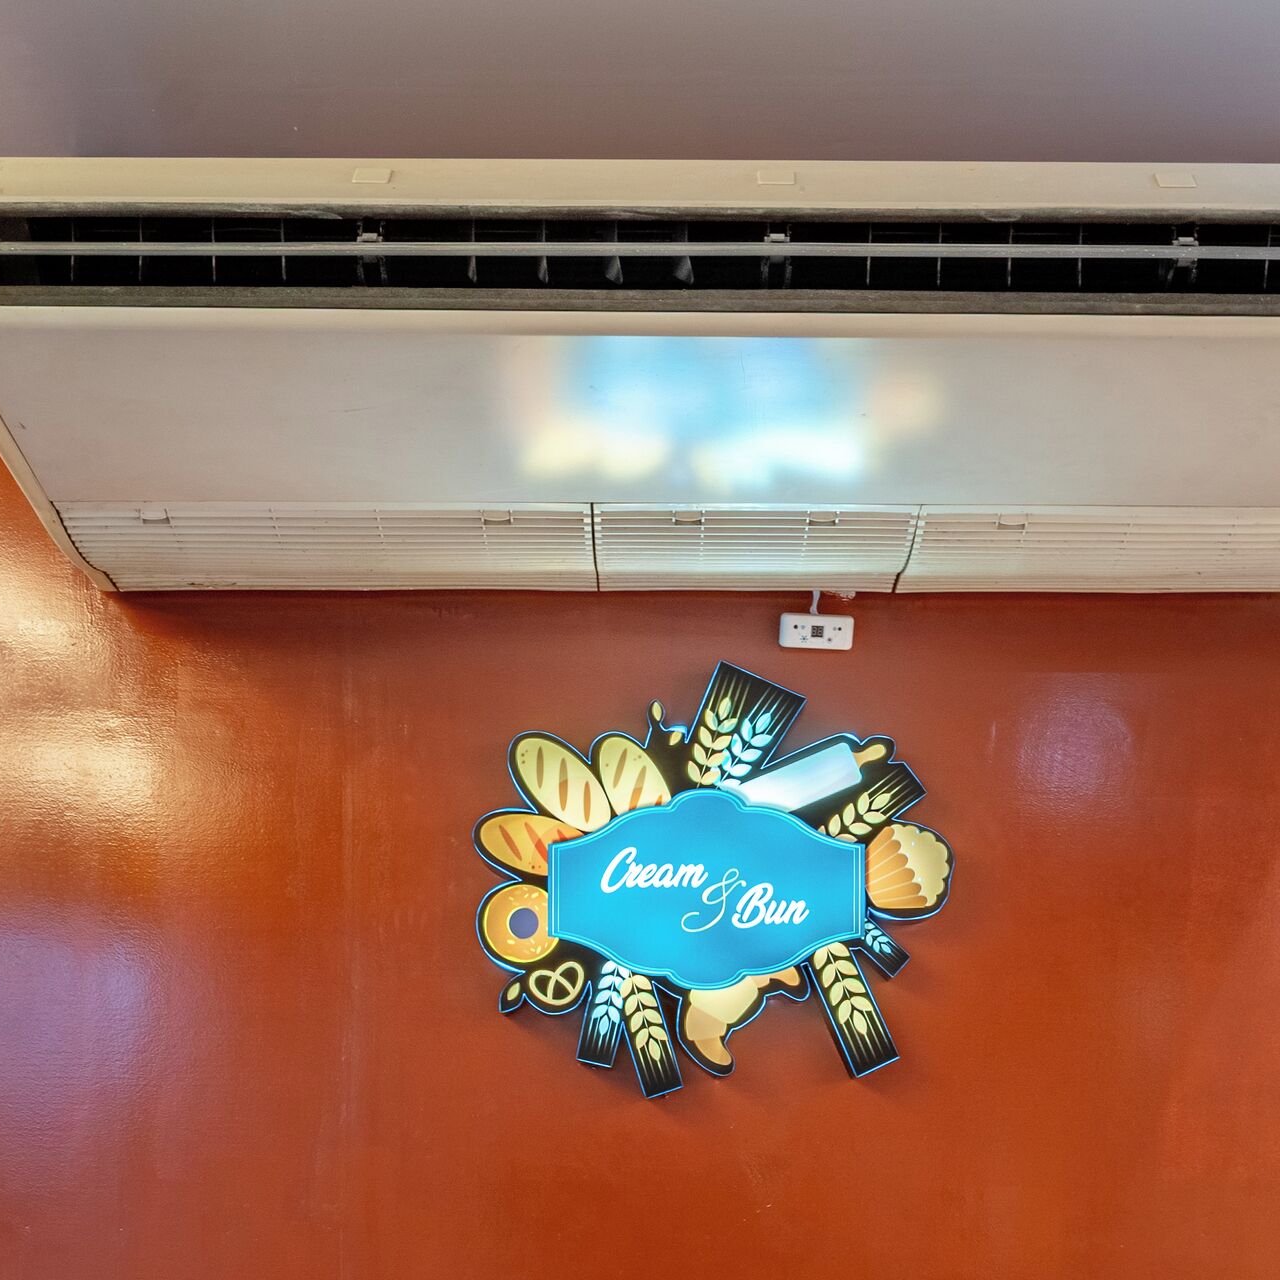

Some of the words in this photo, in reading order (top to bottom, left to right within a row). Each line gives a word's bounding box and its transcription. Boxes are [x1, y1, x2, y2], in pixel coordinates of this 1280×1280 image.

[600, 847, 708, 893] Cream
[681, 867, 747, 932] &
[731, 882, 810, 929] Bun
